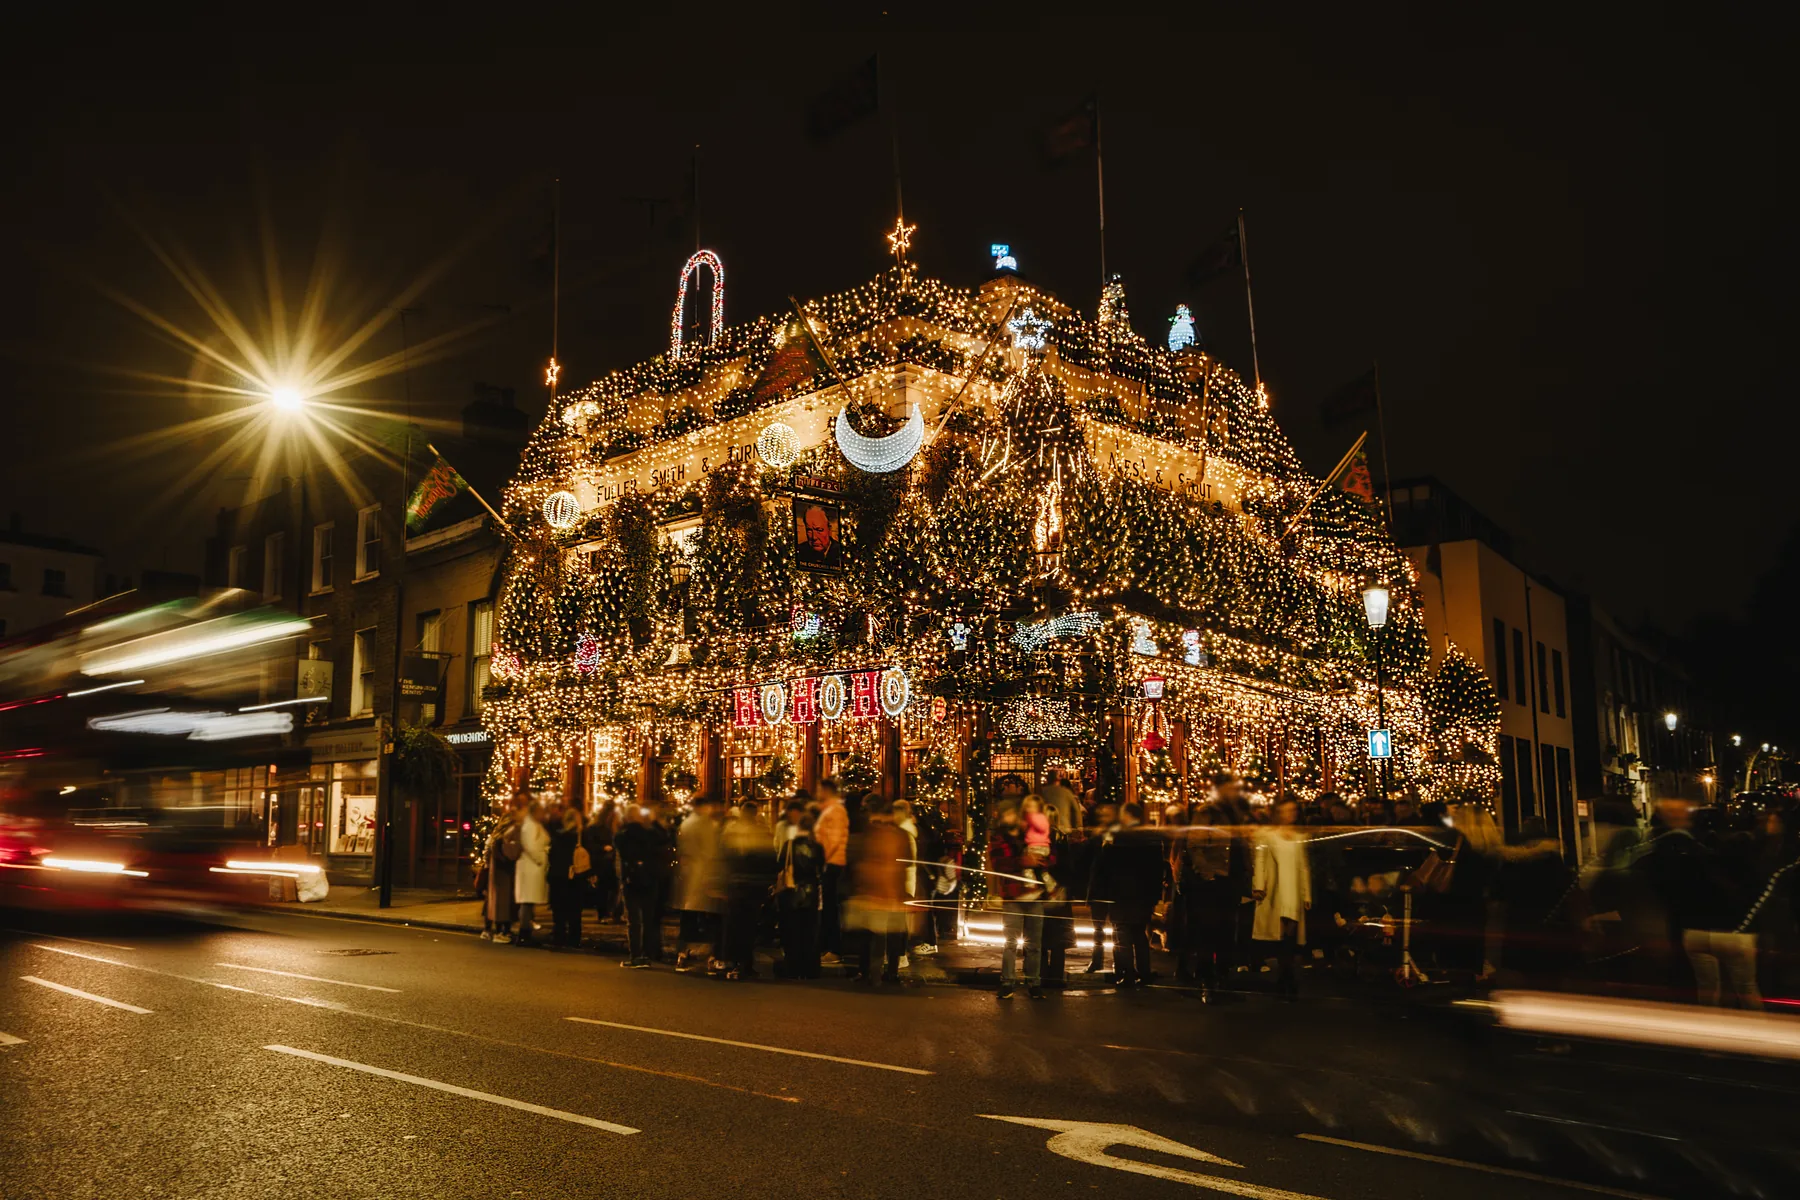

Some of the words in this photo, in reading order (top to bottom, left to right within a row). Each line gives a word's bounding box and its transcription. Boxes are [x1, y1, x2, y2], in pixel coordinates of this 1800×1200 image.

[597, 478, 637, 503] FULLER
[651, 463, 685, 488] SMITH
[701, 457, 711, 473] &
[727, 442, 760, 463] TURN
[1155, 469, 1163, 484] &
